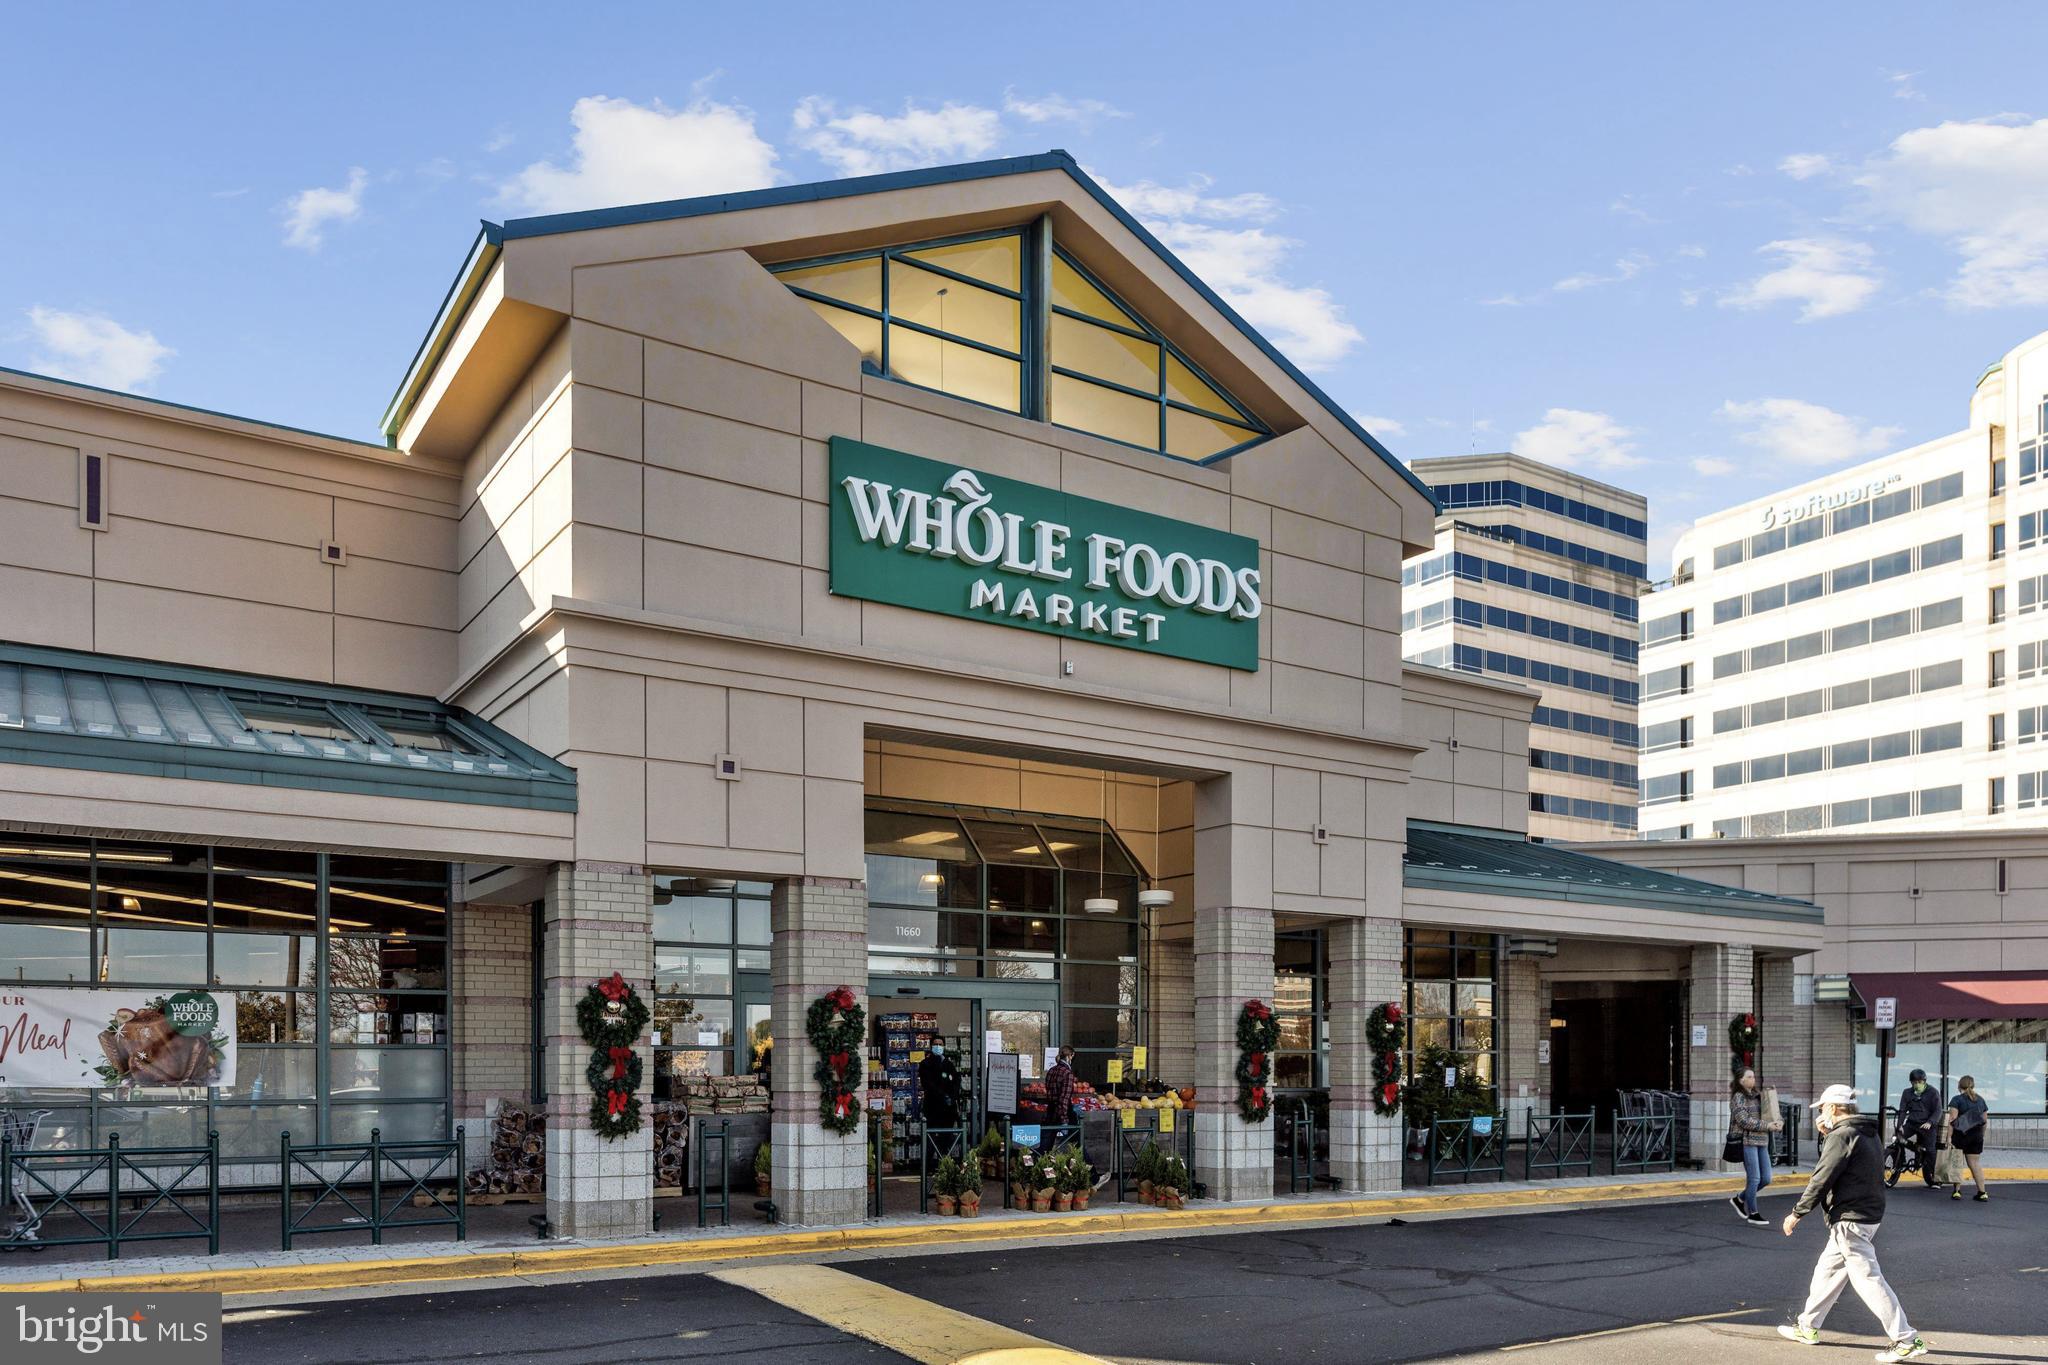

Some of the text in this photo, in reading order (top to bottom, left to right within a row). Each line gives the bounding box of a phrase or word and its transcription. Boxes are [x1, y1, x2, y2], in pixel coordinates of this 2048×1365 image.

[842, 469, 1262, 621] WHOLE FOODS
[970, 578, 1166, 643] MARKET
[895, 926, 921, 937] 11660
[0, 996, 25, 1006] UR
[170, 998, 214, 1012] WHOLE
[173, 1011, 213, 1022] FOODS
[0, 1012, 72, 1064] Meal
[1015, 1133, 1038, 1143] Pickup
